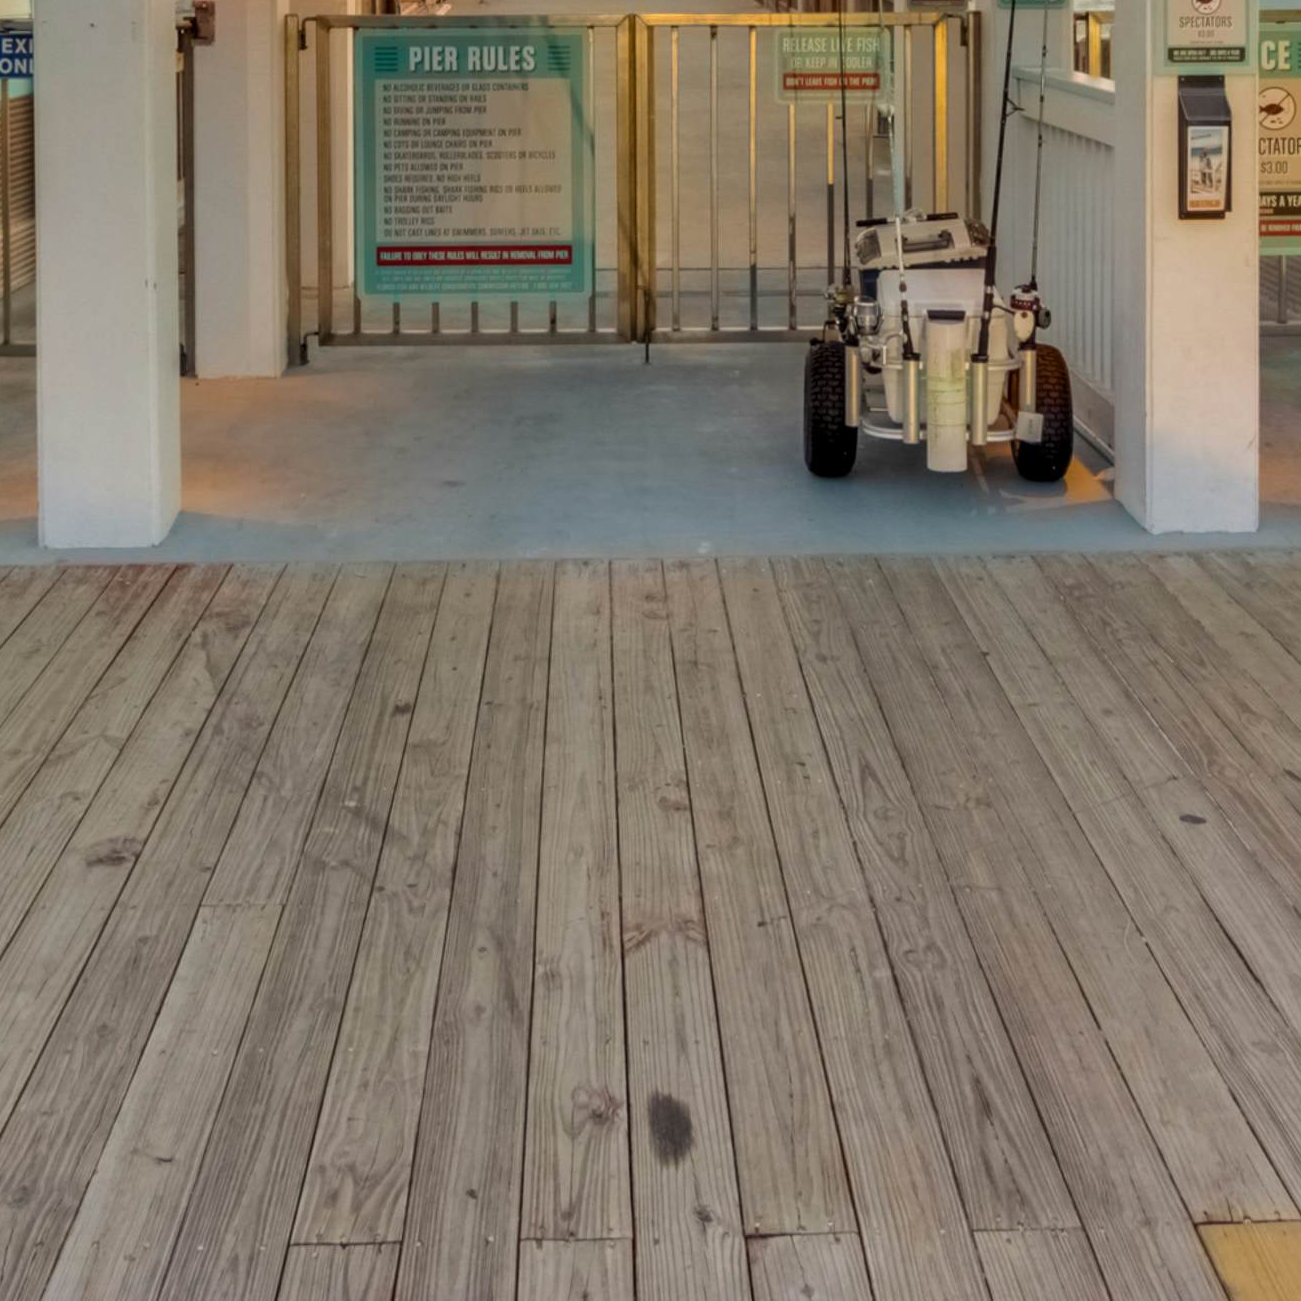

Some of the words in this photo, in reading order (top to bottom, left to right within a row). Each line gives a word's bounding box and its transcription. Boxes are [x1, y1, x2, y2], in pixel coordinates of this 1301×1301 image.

[1179, 17, 1232, 28] SPECTATORS
[1, 37, 33, 54] EXI
[783, 37, 827, 53] RELEASE
[857, 37, 880, 53] FISH
[409, 45, 459, 72] PIER
[467, 45, 536, 72] RULES
[1260, 161, 1288, 174] $3.00
[1259, 195, 1277, 207] AYS
